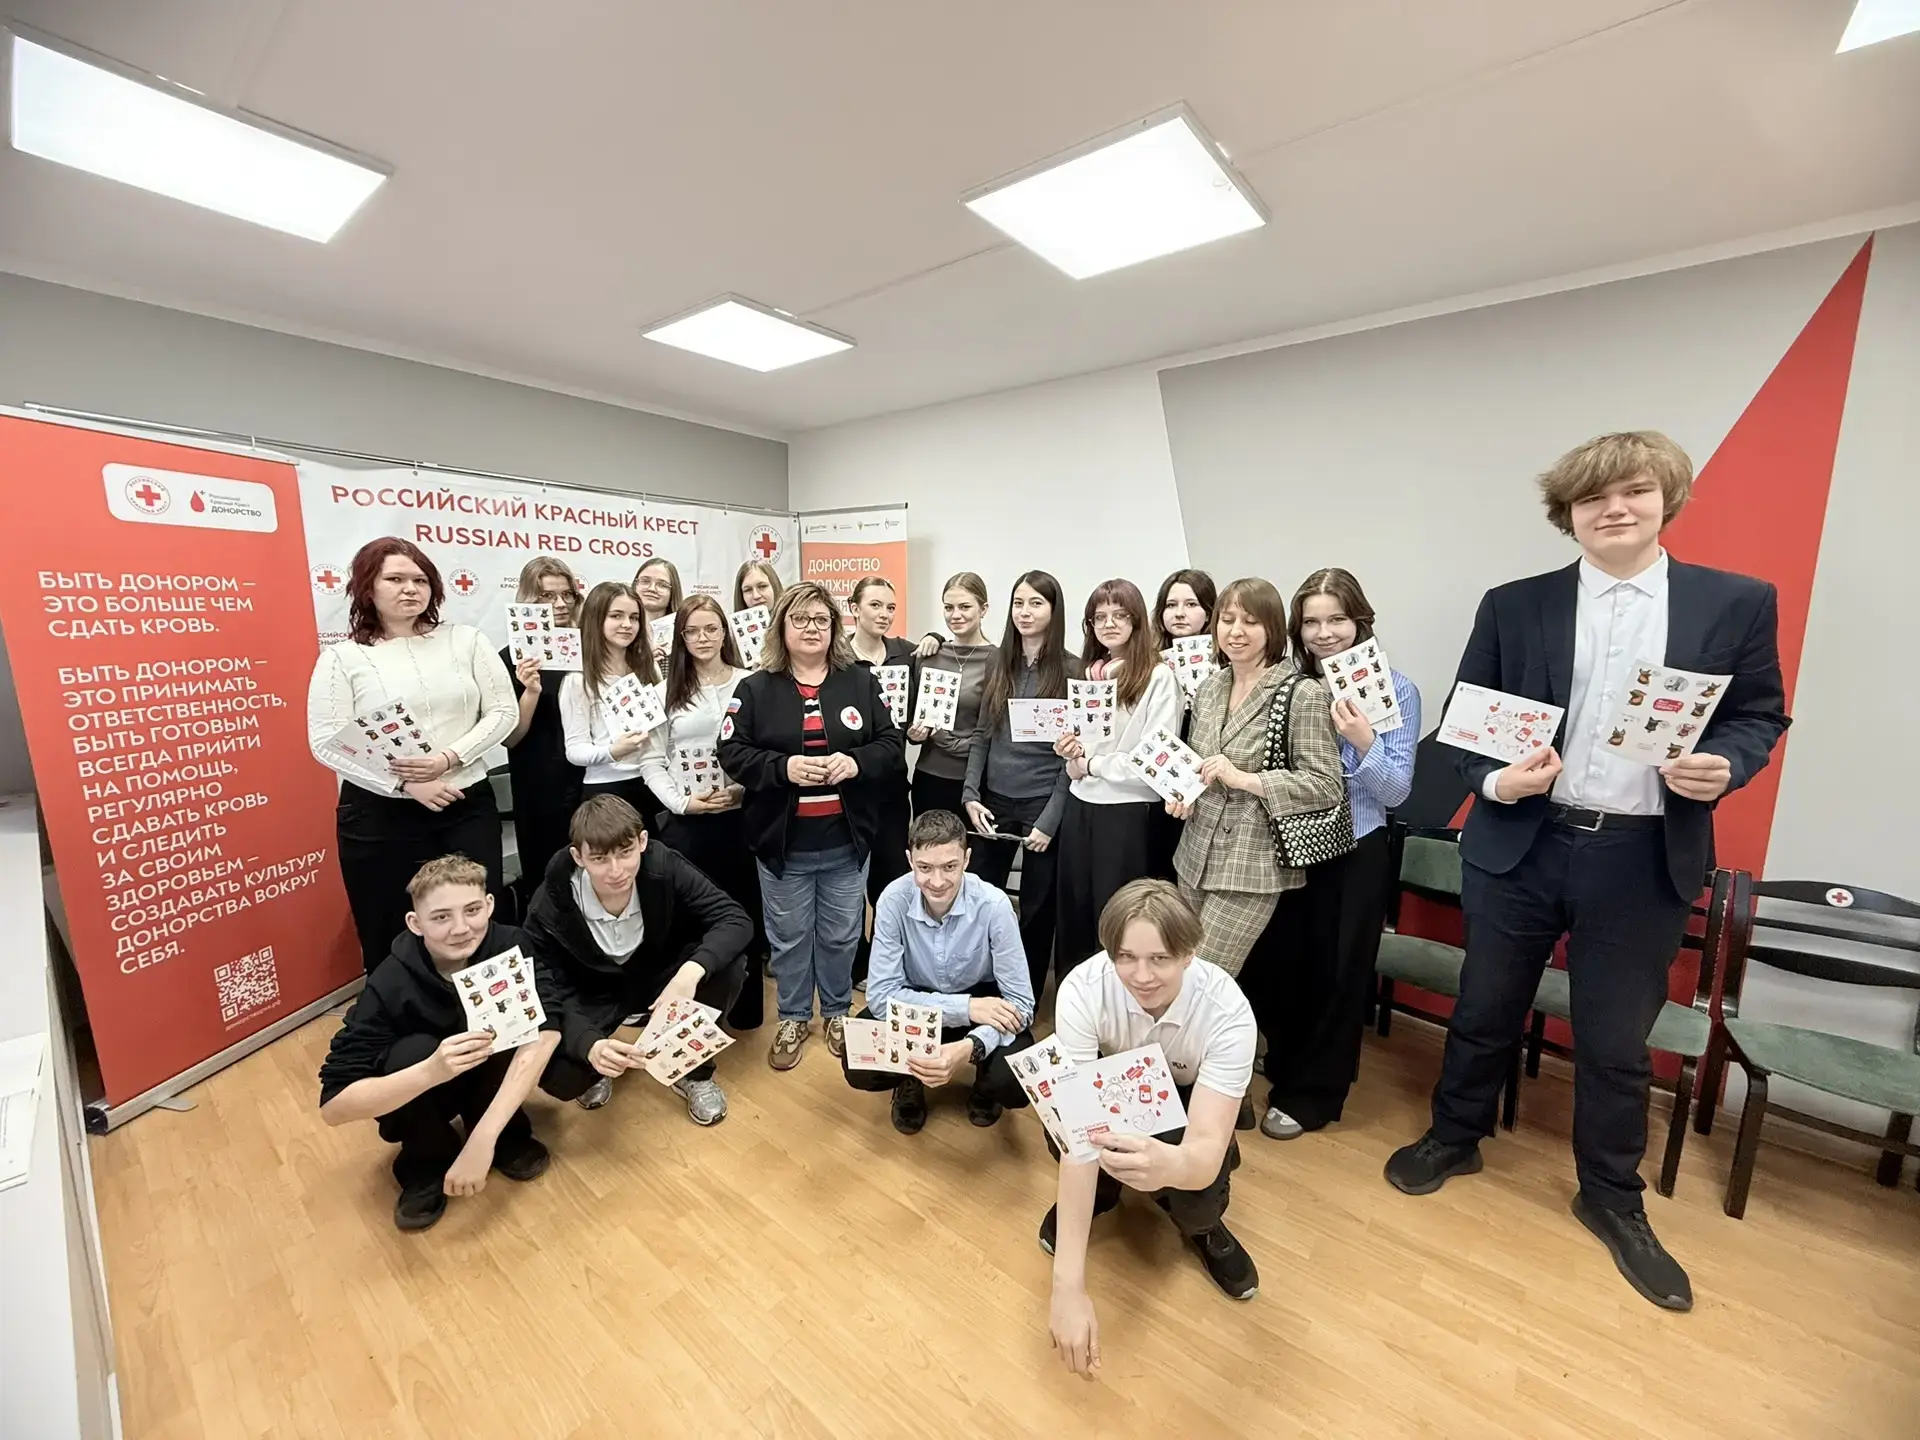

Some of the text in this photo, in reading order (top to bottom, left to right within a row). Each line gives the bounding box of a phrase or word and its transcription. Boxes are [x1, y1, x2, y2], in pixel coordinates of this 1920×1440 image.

[211, 506, 262, 517] ДОНОРСТВО
[330, 485, 699, 536] РОССИЙСКИЙ КРАСНЫЙ КРЕСТ
[415, 523, 653, 557] RUSSIAN RED CROSS
[38, 571, 113, 589] БЫТЬ
[119, 574, 238, 592] ДОНОРОМ
[808, 558, 880, 574] ДОНОРСТВО
[43, 596, 253, 613] ЭТО БОЛЬШЕ ЧЕМ
[48, 618, 220, 639] СДАТЬ КРОВЬ.
[58, 664, 130, 685] БЫТЬ
[136, 657, 251, 682] ДОНОРОМ
[63, 676, 257, 708] ЭТО ПРИНИМАТЬ
[68, 693, 287, 732] ОТВЕТСТВЕННОСТЬ,
[72, 715, 259, 754] БЫТЬ ГОТОВЫМ
[77, 734, 261, 778] ВСЕГДА ПРИЙТИ
[82, 760, 239, 800] НА ПОМОЩЬ,
[87, 782, 223, 823] РЕГУЛЯРНО
[92, 792, 268, 845] СДАВАТЬ КРОВЬ
[96, 823, 227, 868] И СЛЕДИТЬ
[101, 843, 223, 890] ЗА СВОИМ
[105, 857, 244, 911] ЗДОРОВЬЕМ
[110, 848, 326, 932] СОЗДАВАТЬ КУЛЬТУРУ
[115, 869, 320, 957] ДОНОРСТВА ВОКРУГ
[119, 940, 185, 977] СЕБЯ.
